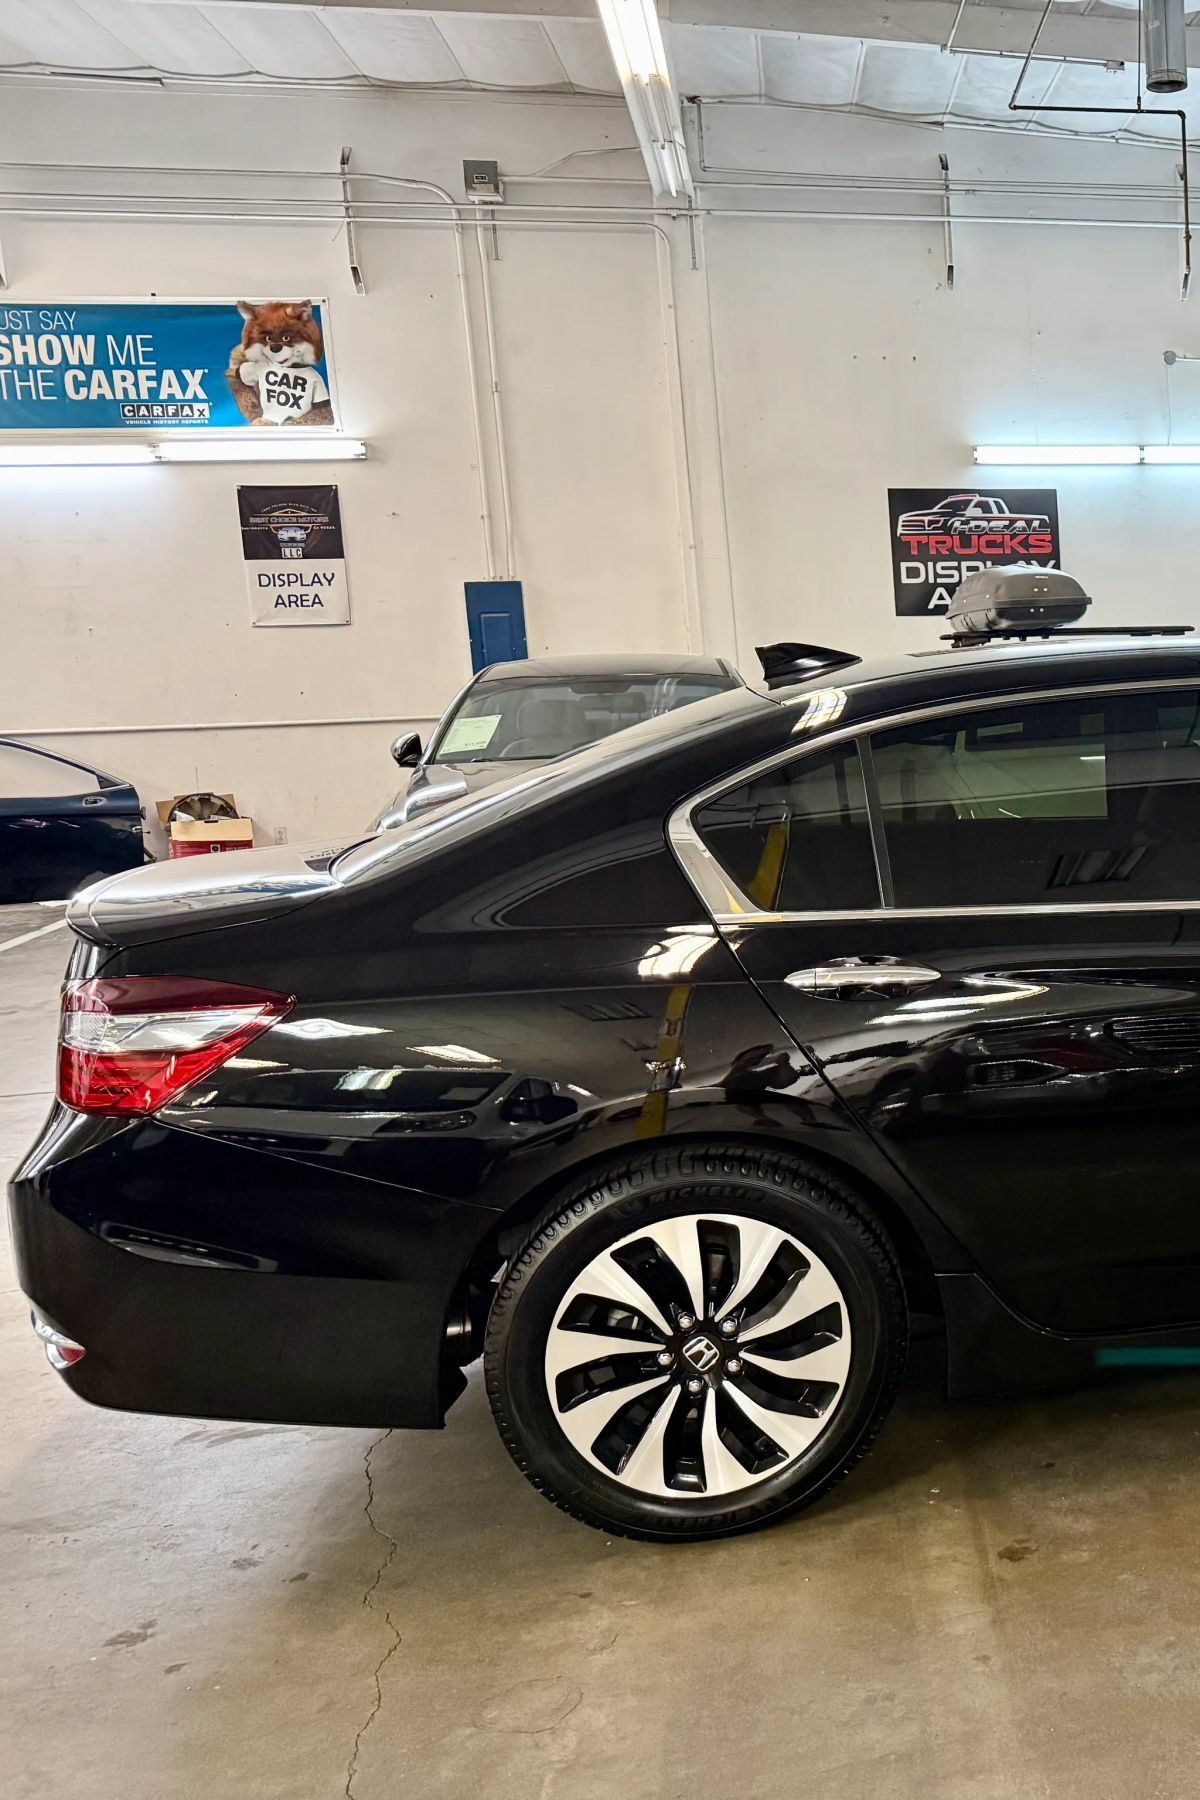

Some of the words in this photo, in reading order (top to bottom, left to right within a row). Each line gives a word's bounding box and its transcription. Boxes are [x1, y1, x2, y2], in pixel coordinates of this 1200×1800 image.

[39, 310, 76, 331] SAY
[0, 334, 95, 366] SHOW
[106, 334, 156, 366] ME
[0, 369, 57, 400] THE
[64, 368, 209, 400] CARFAX
[265, 370, 308, 392] CAR
[266, 388, 304, 410] FOX
[951, 520, 1051, 535] I-DEAL
[282, 547, 303, 558] LLC
[900, 534, 1053, 556] TRUCKS
[257, 572, 335, 588] DISPLAY
[274, 593, 324, 608] AREA
